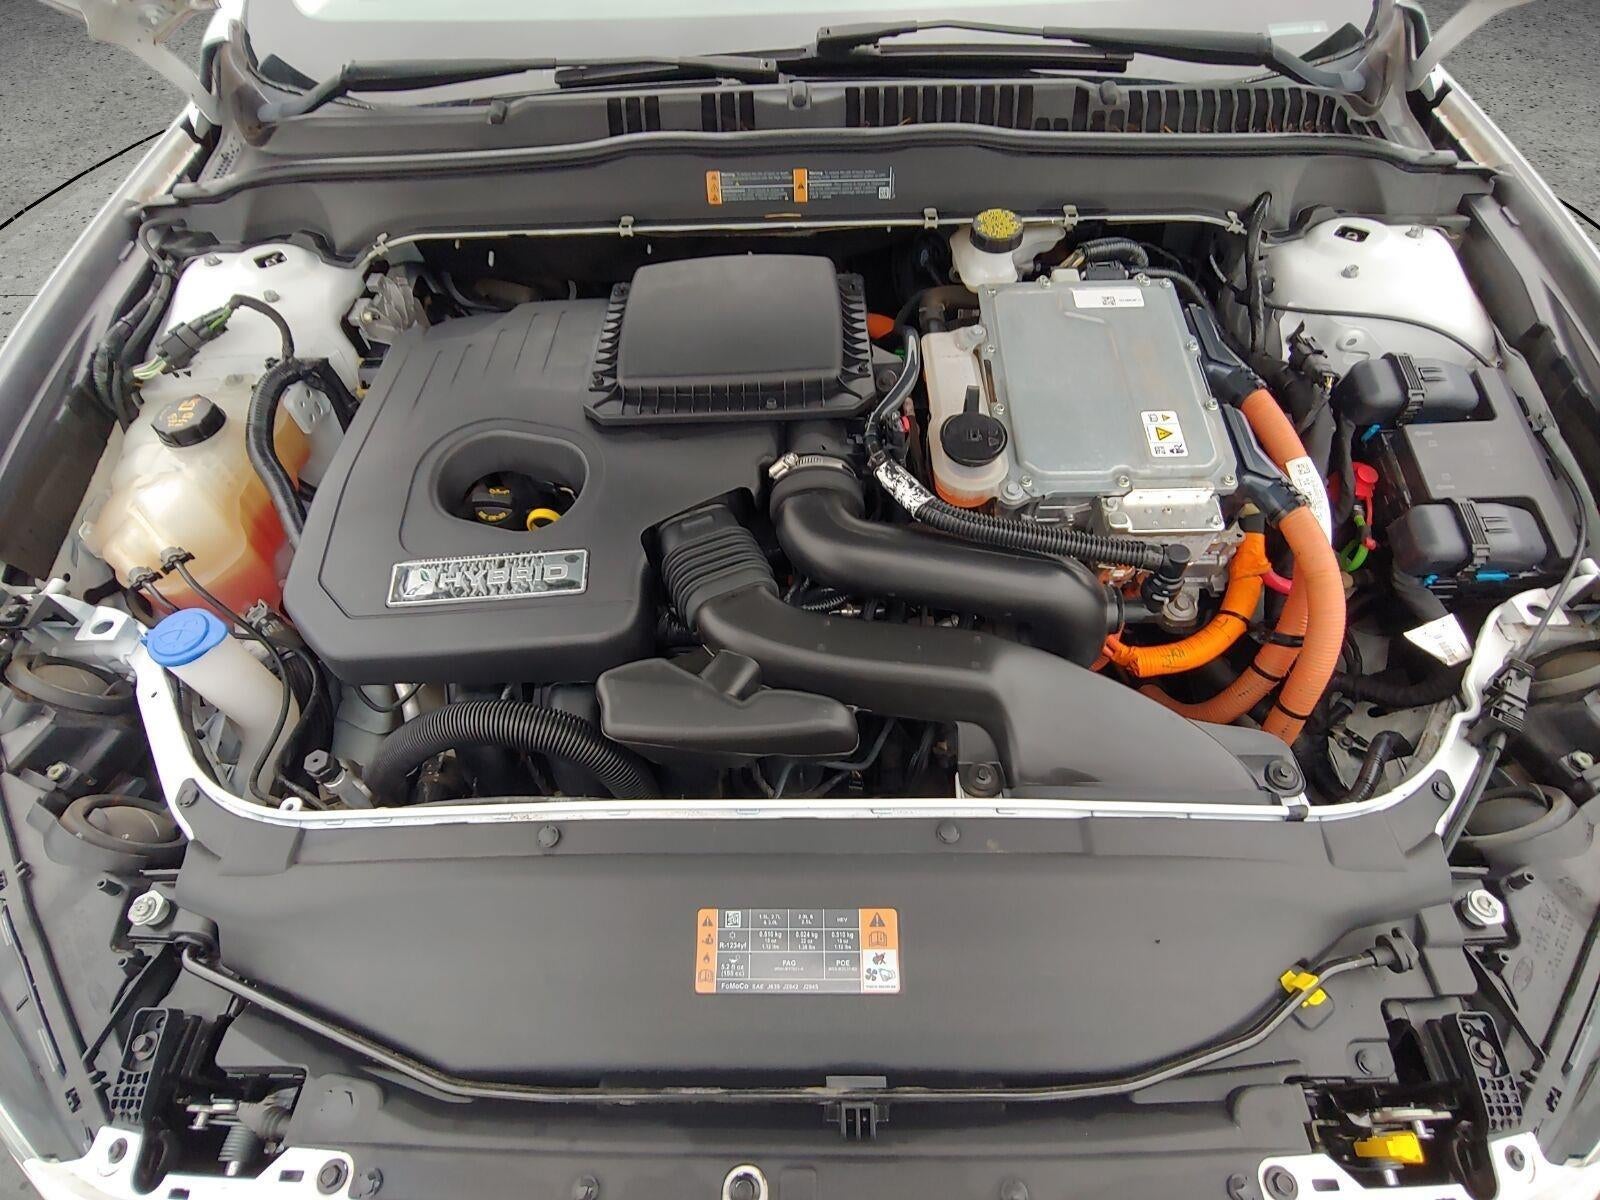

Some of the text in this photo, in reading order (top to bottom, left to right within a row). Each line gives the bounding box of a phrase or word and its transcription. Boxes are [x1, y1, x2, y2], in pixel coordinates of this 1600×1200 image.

[439, 561, 569, 589] HYBRID
[719, 941, 747, 950] R-1234yf
[782, 959, 797, 967] PAG
[721, 982, 749, 990] FoMoCo
